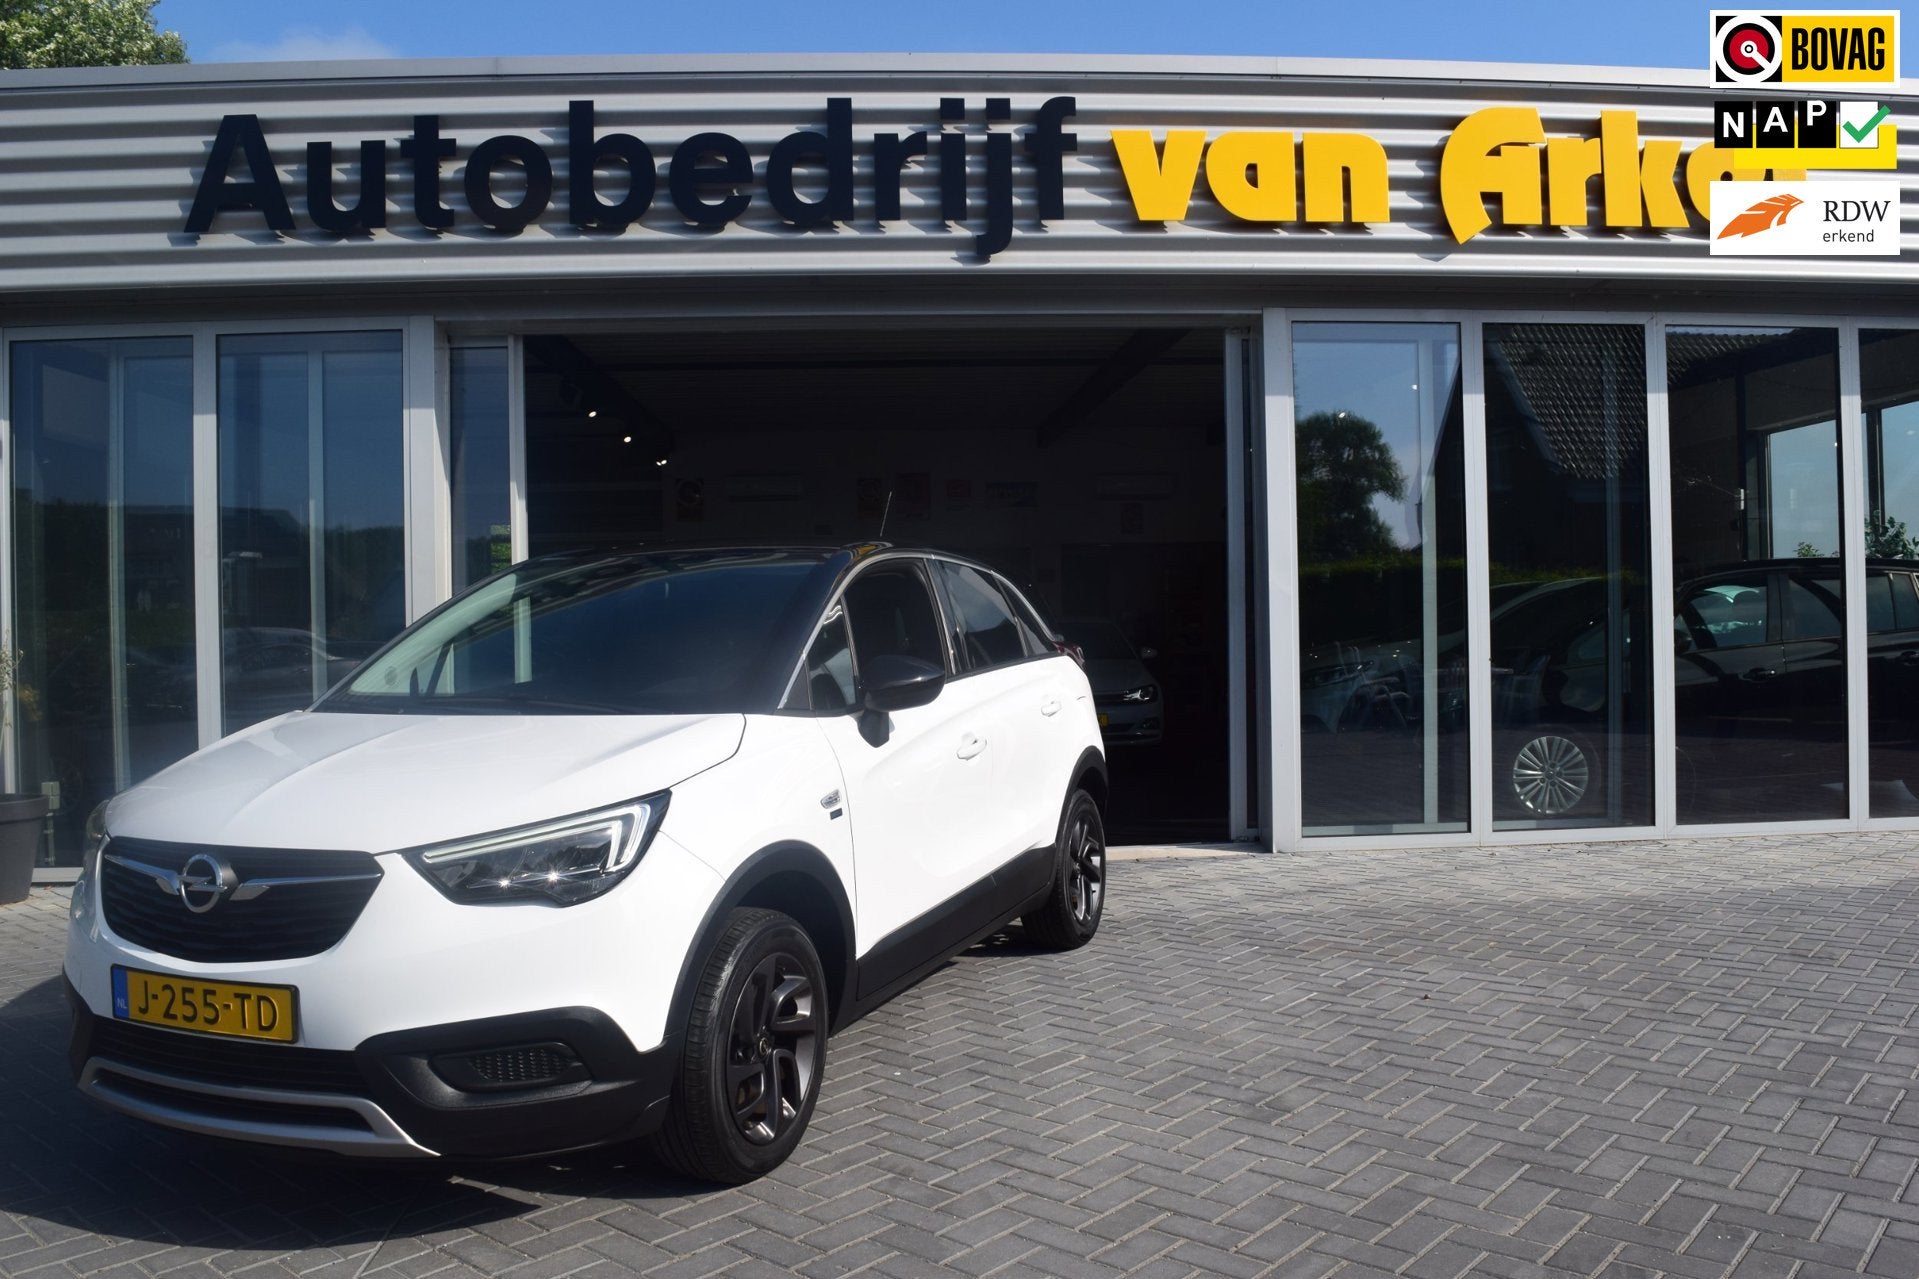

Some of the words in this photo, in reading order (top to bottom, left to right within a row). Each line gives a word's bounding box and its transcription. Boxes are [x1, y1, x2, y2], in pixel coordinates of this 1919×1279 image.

[184, 95, 1078, 256] Autobedrijf
[1110, 130, 1390, 223] van
[1440, 106, 1808, 245] Ark
[116, 997, 128, 1009] NL
[138, 980, 279, 1032] J-255-TD
